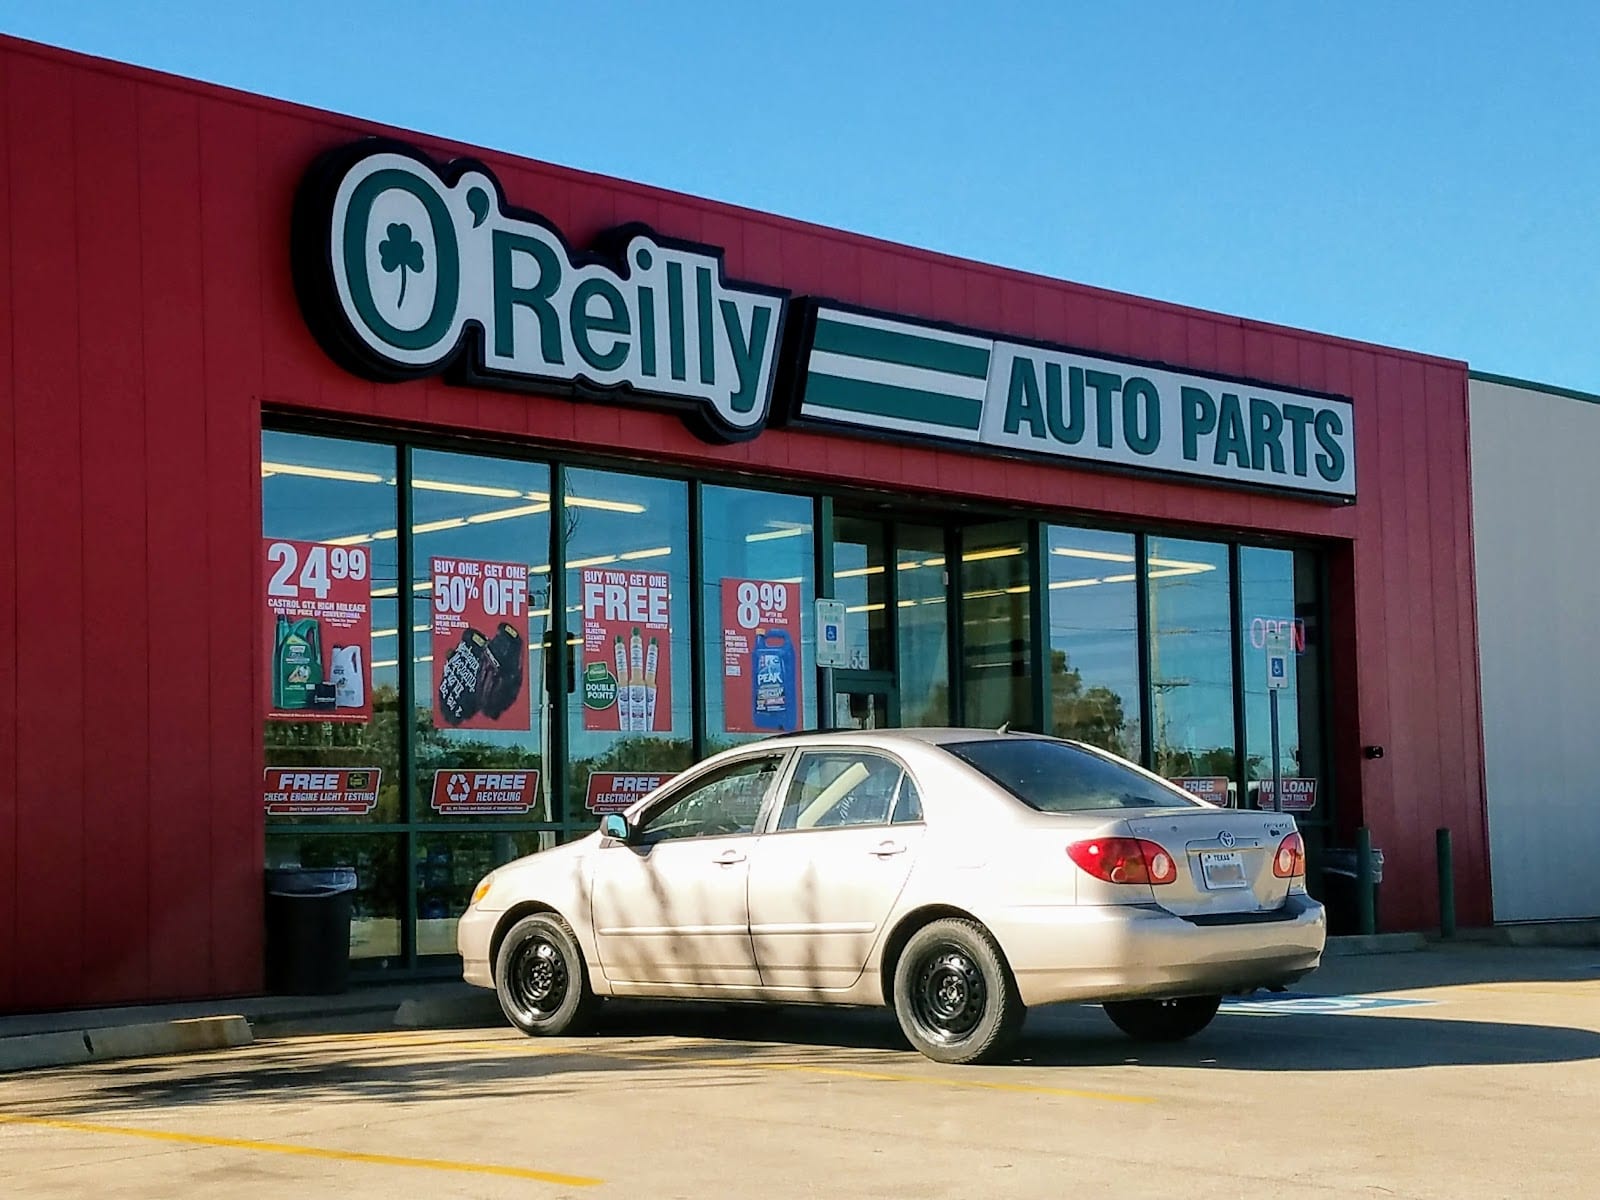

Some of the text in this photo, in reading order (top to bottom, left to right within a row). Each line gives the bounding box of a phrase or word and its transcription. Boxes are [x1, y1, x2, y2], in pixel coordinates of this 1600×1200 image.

[343, 168, 772, 413] O'Reilly
[1003, 356, 1345, 482] AUTO PARTS
[434, 560, 526, 579] BUY ONE, GET ONE
[584, 571, 667, 587] BUY TWO, GET ONE
[435, 575, 526, 616] 50% OFF
[585, 583, 668, 623] FREE
[268, 598, 366, 612] CASTROL GTX HIGH MILEAGE
[757, 672, 784, 686] PEAK
[586, 684, 615, 692] DOUBLE
[279, 773, 340, 790] FREE
[473, 774, 527, 790] FREE
[612, 776, 660, 792] FREE
[1183, 780, 1215, 792] FREE
[1282, 782, 1314, 793] LOAN
[264, 792, 375, 801] CHECK ENGINE LIGHT TESTING
[476, 791, 521, 802] RECYCLING
[597, 793, 639, 802] ELECTRICAL
